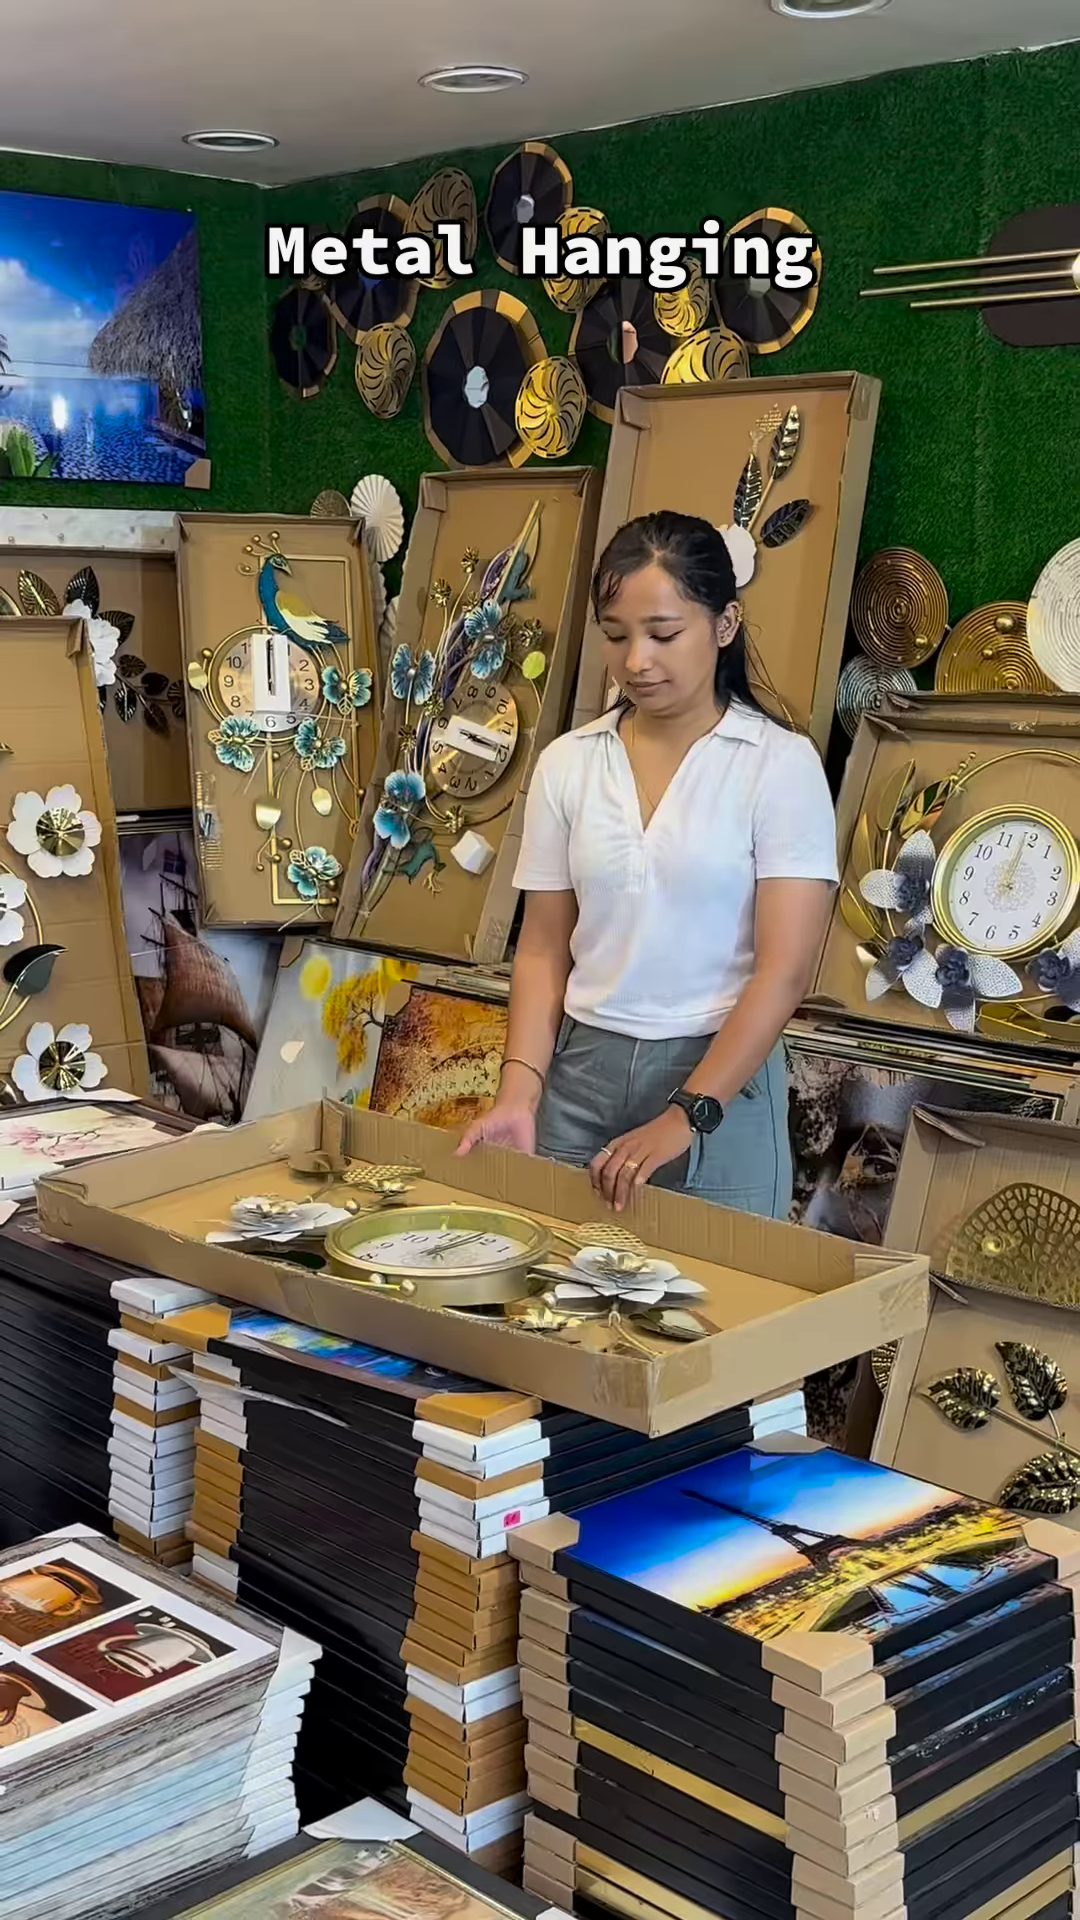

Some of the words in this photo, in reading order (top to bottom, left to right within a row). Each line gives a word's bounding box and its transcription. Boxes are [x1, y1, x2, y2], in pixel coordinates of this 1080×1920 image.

[226, 656, 242, 669] 10
[299, 659, 309, 672] 2
[223, 675, 234, 687] 9
[304, 678, 315, 691] 3
[467, 685, 479, 698] 8
[485, 686, 497, 699] 9
[230, 695, 241, 708] 8
[299, 698, 310, 711] 4
[452, 697, 462, 710] 7
[496, 698, 509, 715] 10
[265, 715, 276, 728] 6
[286, 711, 297, 724] 5
[437, 716, 449, 730] 6
[501, 721, 514, 736] 11
[432, 740, 444, 754] 5
[496, 743, 510, 763] 12
[437, 762, 448, 774] 4
[449, 775, 461, 789] 3
[464, 777, 477, 792] 2
[997, 831, 1014, 849] 11
[974, 843, 993, 861] 10
[1043, 844, 1052, 860] 1
[963, 865, 975, 881] 9
[1050, 865, 1062, 881] 2
[959, 890, 971, 905] 8
[1046, 891, 1058, 906] 3
[968, 911, 980, 927] 7
[1032, 912, 1042, 928] 4
[985, 924, 997, 940] 6
[1008, 925, 1021, 940] 5
[402, 1234, 429, 1243] 10
[496, 1245, 511, 1253] 1
